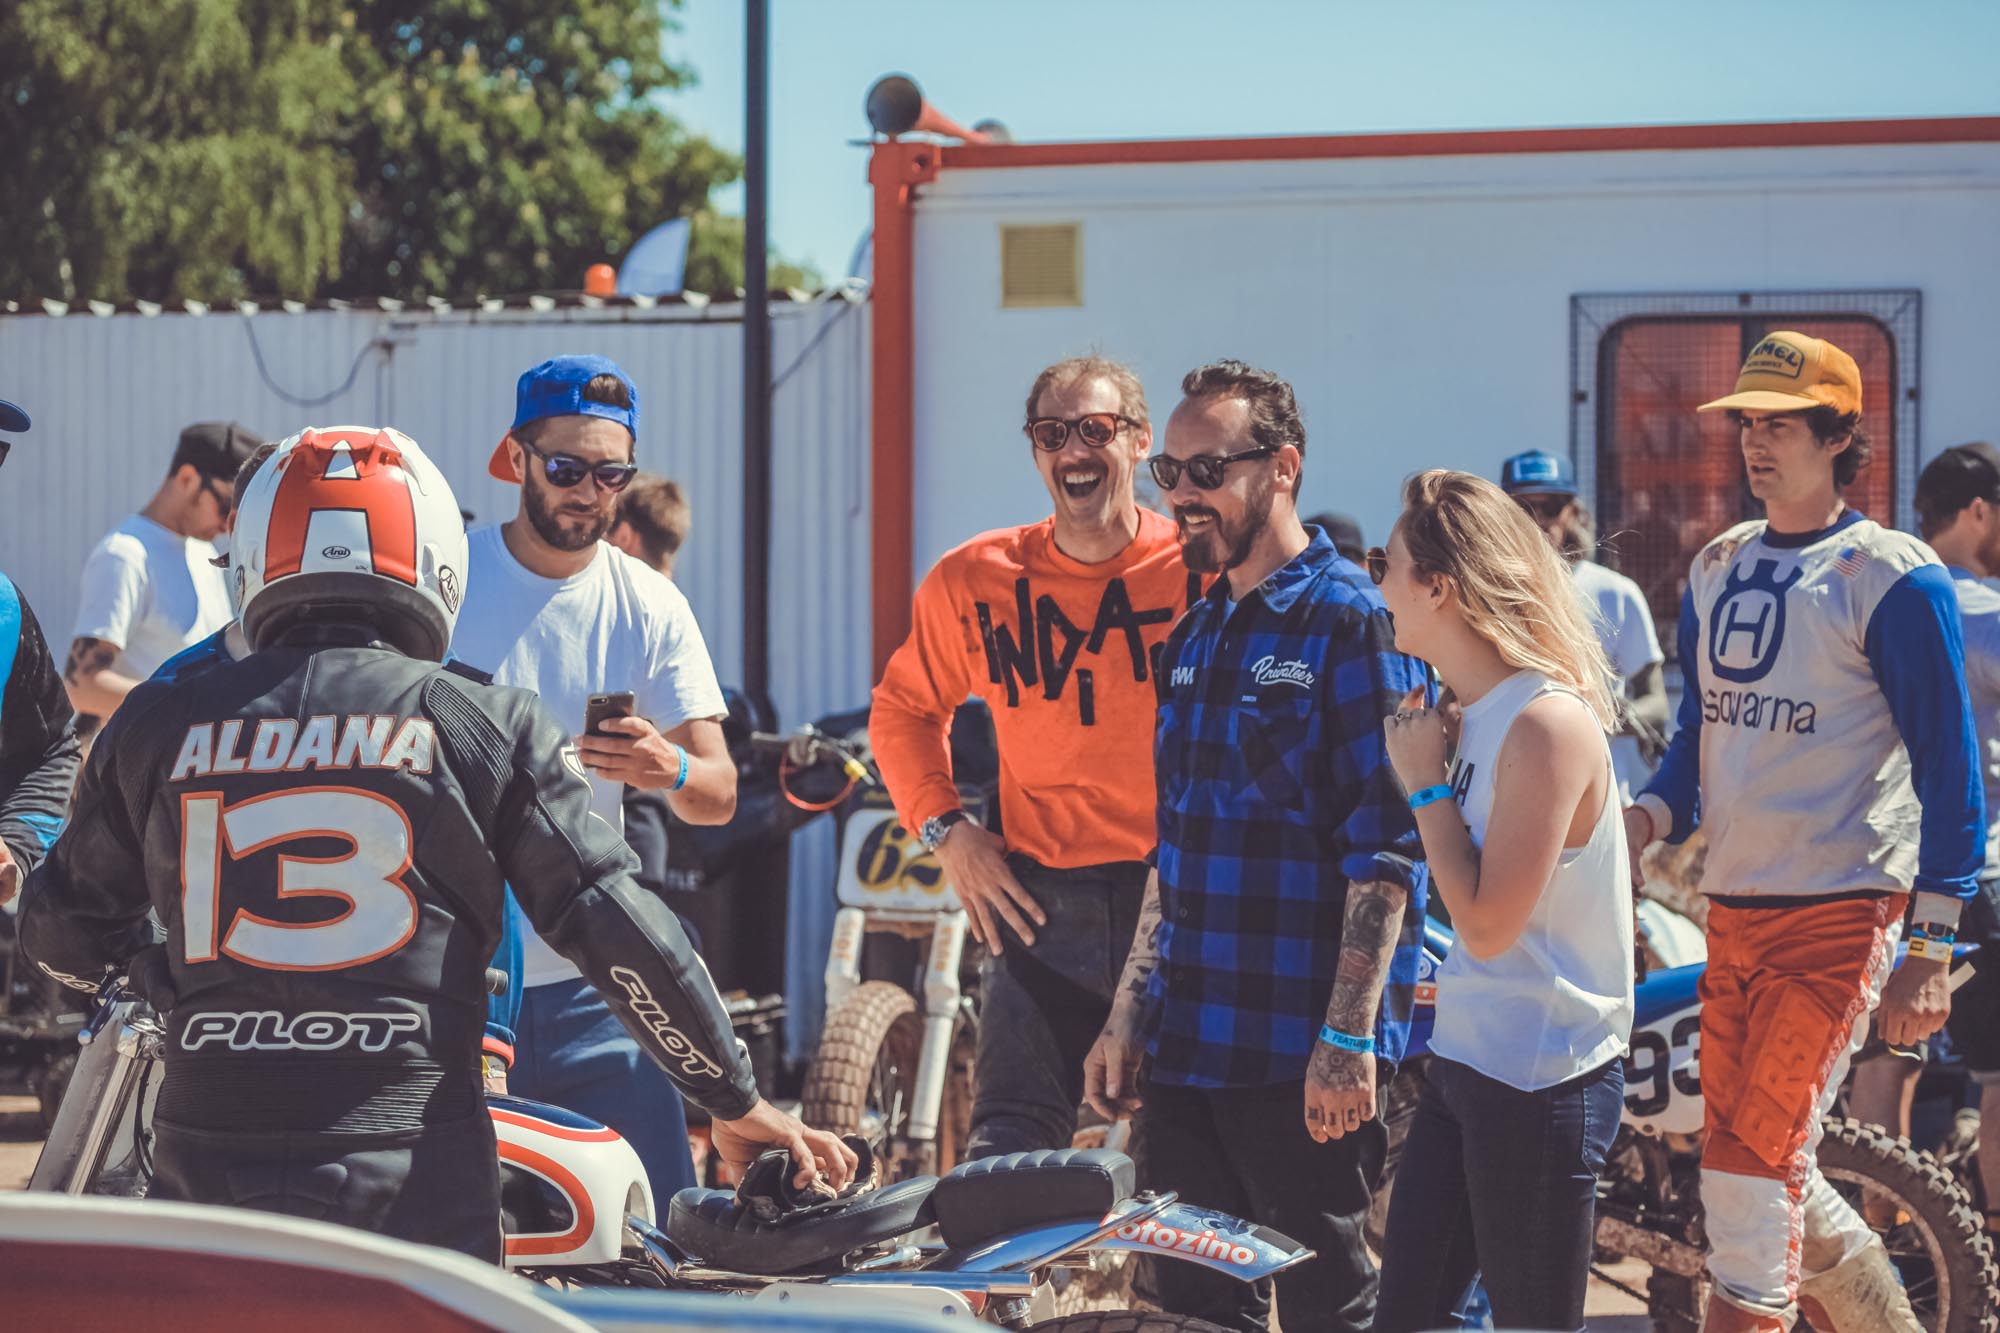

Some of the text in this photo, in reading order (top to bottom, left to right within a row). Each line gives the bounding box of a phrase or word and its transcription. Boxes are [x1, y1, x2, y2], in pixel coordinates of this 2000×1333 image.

[1251, 655, 1315, 689] Privateer
[168, 714, 434, 782] ALDANA
[181, 785, 419, 972] 13
[181, 1011, 421, 1052] PILOT
[611, 965, 723, 1078] PILOT
[1103, 1213, 1257, 1266] otozino
